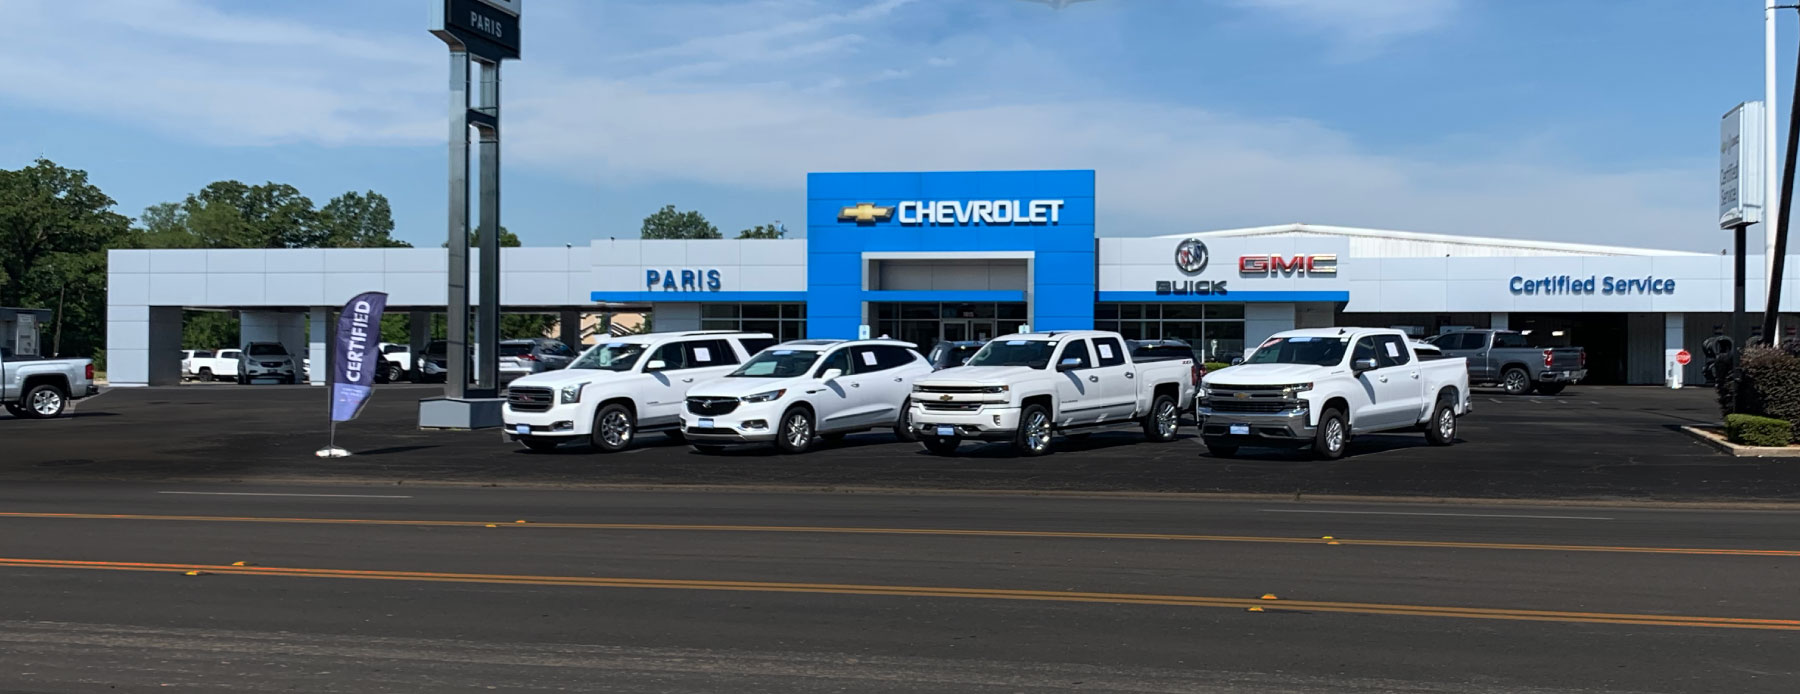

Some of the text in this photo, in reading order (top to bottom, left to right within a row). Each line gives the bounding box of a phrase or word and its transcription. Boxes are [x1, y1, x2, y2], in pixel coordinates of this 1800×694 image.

[470, 11, 502, 38] PARIS
[898, 199, 1064, 225] CHEVROLET
[1238, 253, 1338, 275] GMC
[646, 269, 722, 290] PARIS
[1155, 280, 1228, 295] BUICK
[1509, 275, 1676, 295] Certified Service
[346, 300, 370, 382] CERTIFIED
